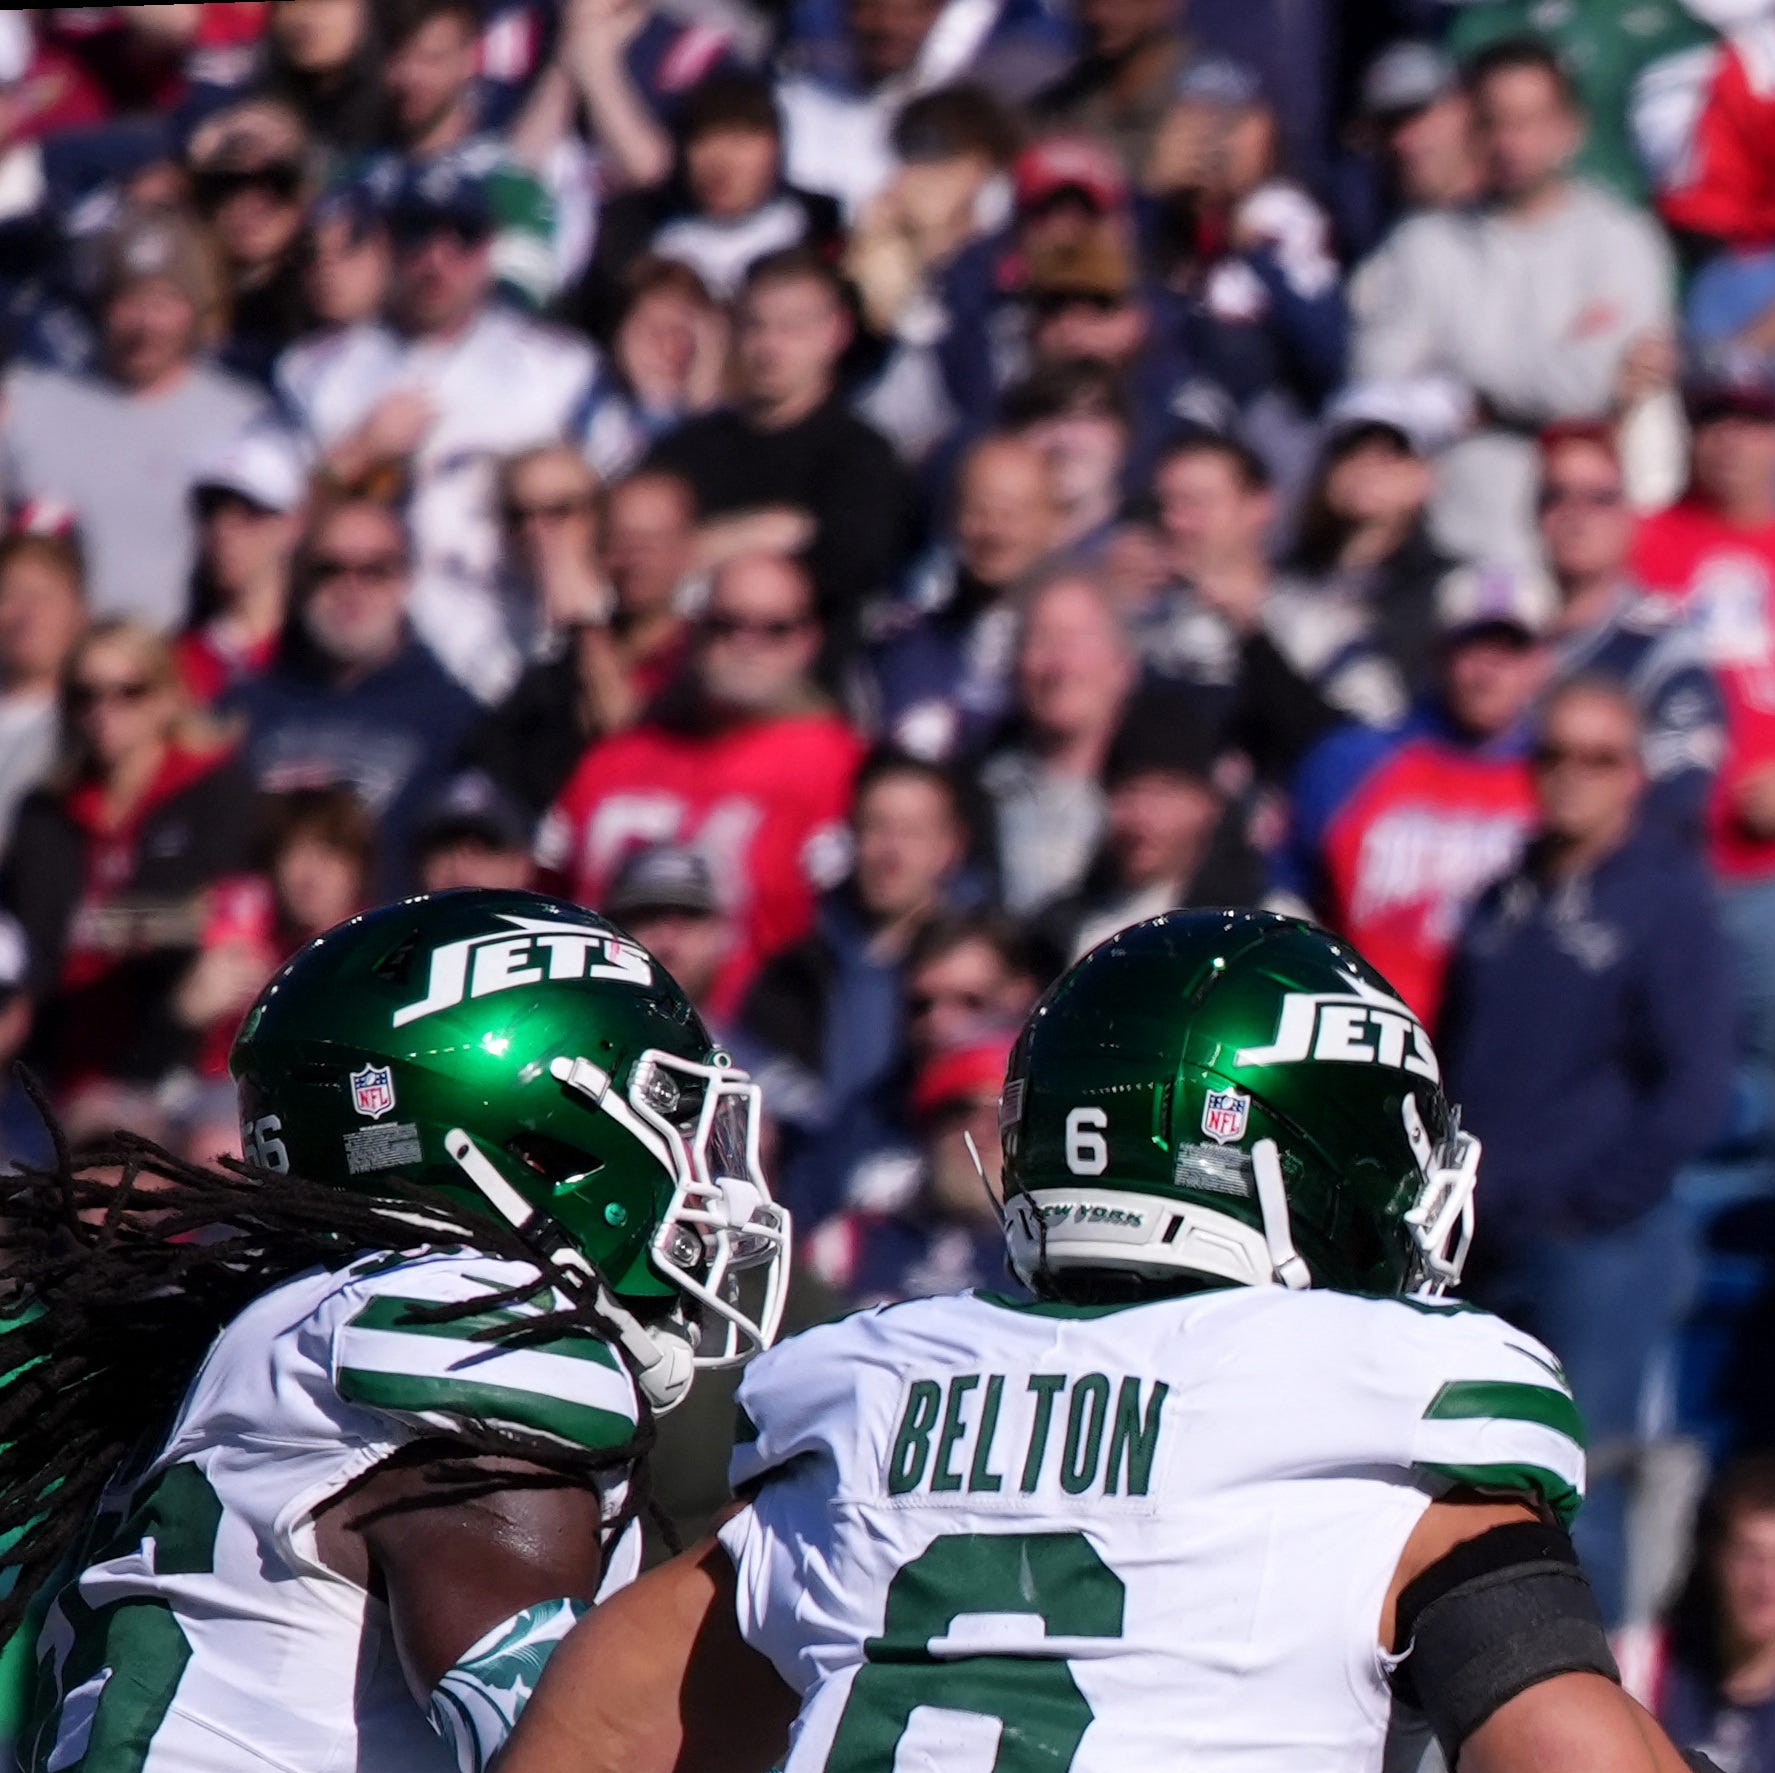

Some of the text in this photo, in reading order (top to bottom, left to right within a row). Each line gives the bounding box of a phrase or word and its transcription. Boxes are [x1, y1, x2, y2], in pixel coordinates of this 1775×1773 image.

[393, 914, 653, 1029] JETS
[1233, 967, 1440, 1085] JETS
[1065, 1106, 1109, 1176] 6
[1207, 1110, 1241, 1136] NFL
[1079, 1202, 1143, 1228] YORK
[888, 1372, 1170, 1498] BELTON
